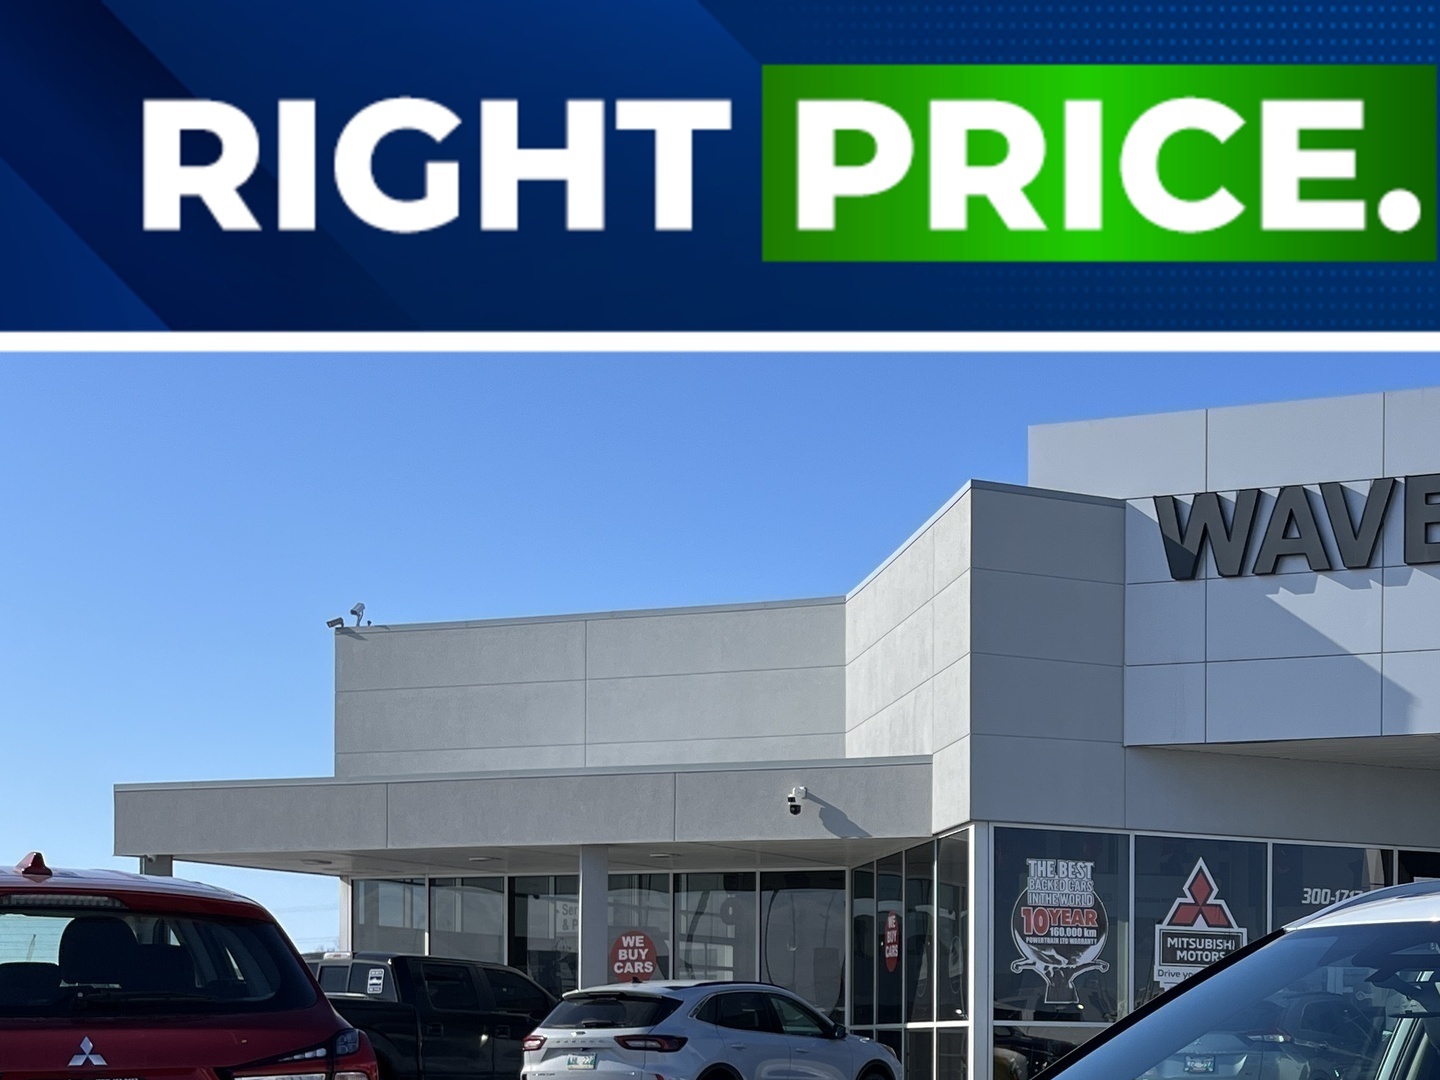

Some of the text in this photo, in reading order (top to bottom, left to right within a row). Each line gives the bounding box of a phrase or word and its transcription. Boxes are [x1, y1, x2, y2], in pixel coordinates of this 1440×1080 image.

[1027, 859, 1094, 879] THE BEST
[1028, 879, 1094, 893] BACKED CARS
[1028, 892, 1094, 907] IN THE WORLD
[1048, 908, 1098, 927] YEAR
[1050, 927, 1097, 938] 160,000 km
[622, 935, 645, 948] WE
[1167, 937, 1236, 951] MITSUBISHI
[618, 948, 649, 961] BUY
[613, 961, 654, 974] CARS
[1157, 969, 1181, 978] Drive
